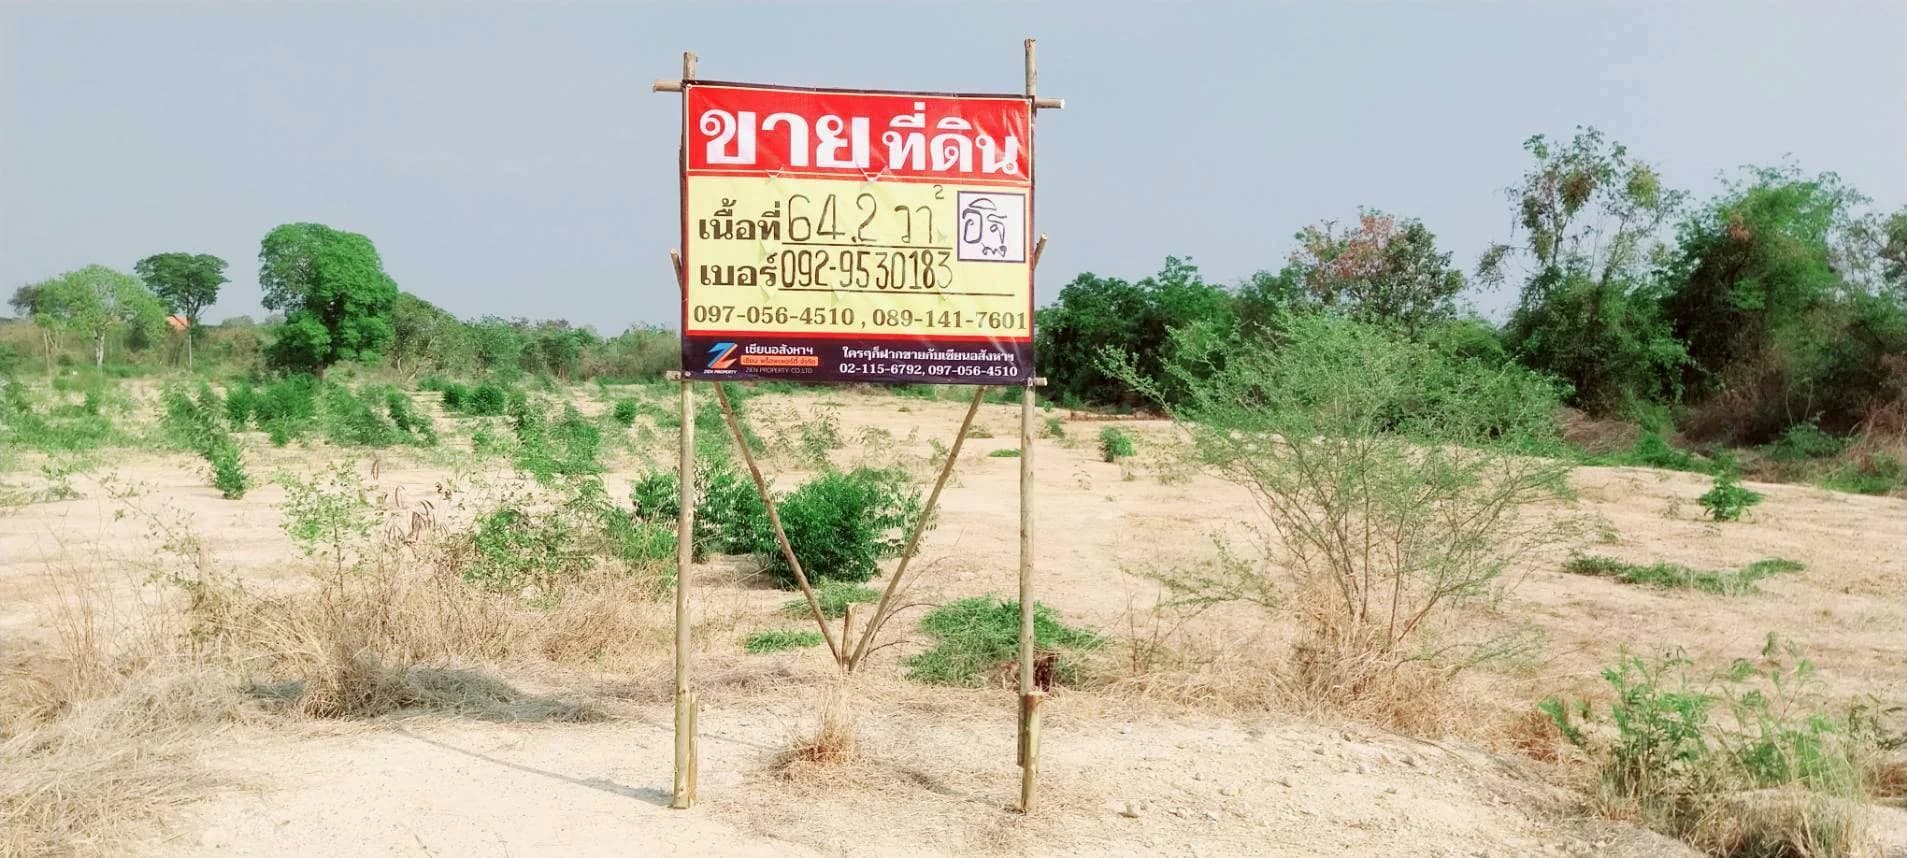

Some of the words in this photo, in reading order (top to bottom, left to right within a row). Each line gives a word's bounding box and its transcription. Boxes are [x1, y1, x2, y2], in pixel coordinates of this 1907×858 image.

[699, 108, 870, 169] ขาย
[881, 101, 1019, 175] ที่ดิน
[699, 198, 781, 241] เนื้อที่
[788, 193, 877, 243] 64.2
[700, 252, 777, 286] เบอร์
[781, 249, 953, 290] 092-9530183
[693, 305, 855, 326] 097-056-4510
[872, 308, 1027, 331] 089-141-7601
[839, 362, 926, 377] 02-115-6792,
[928, 364, 1018, 377] 097-056-4510
